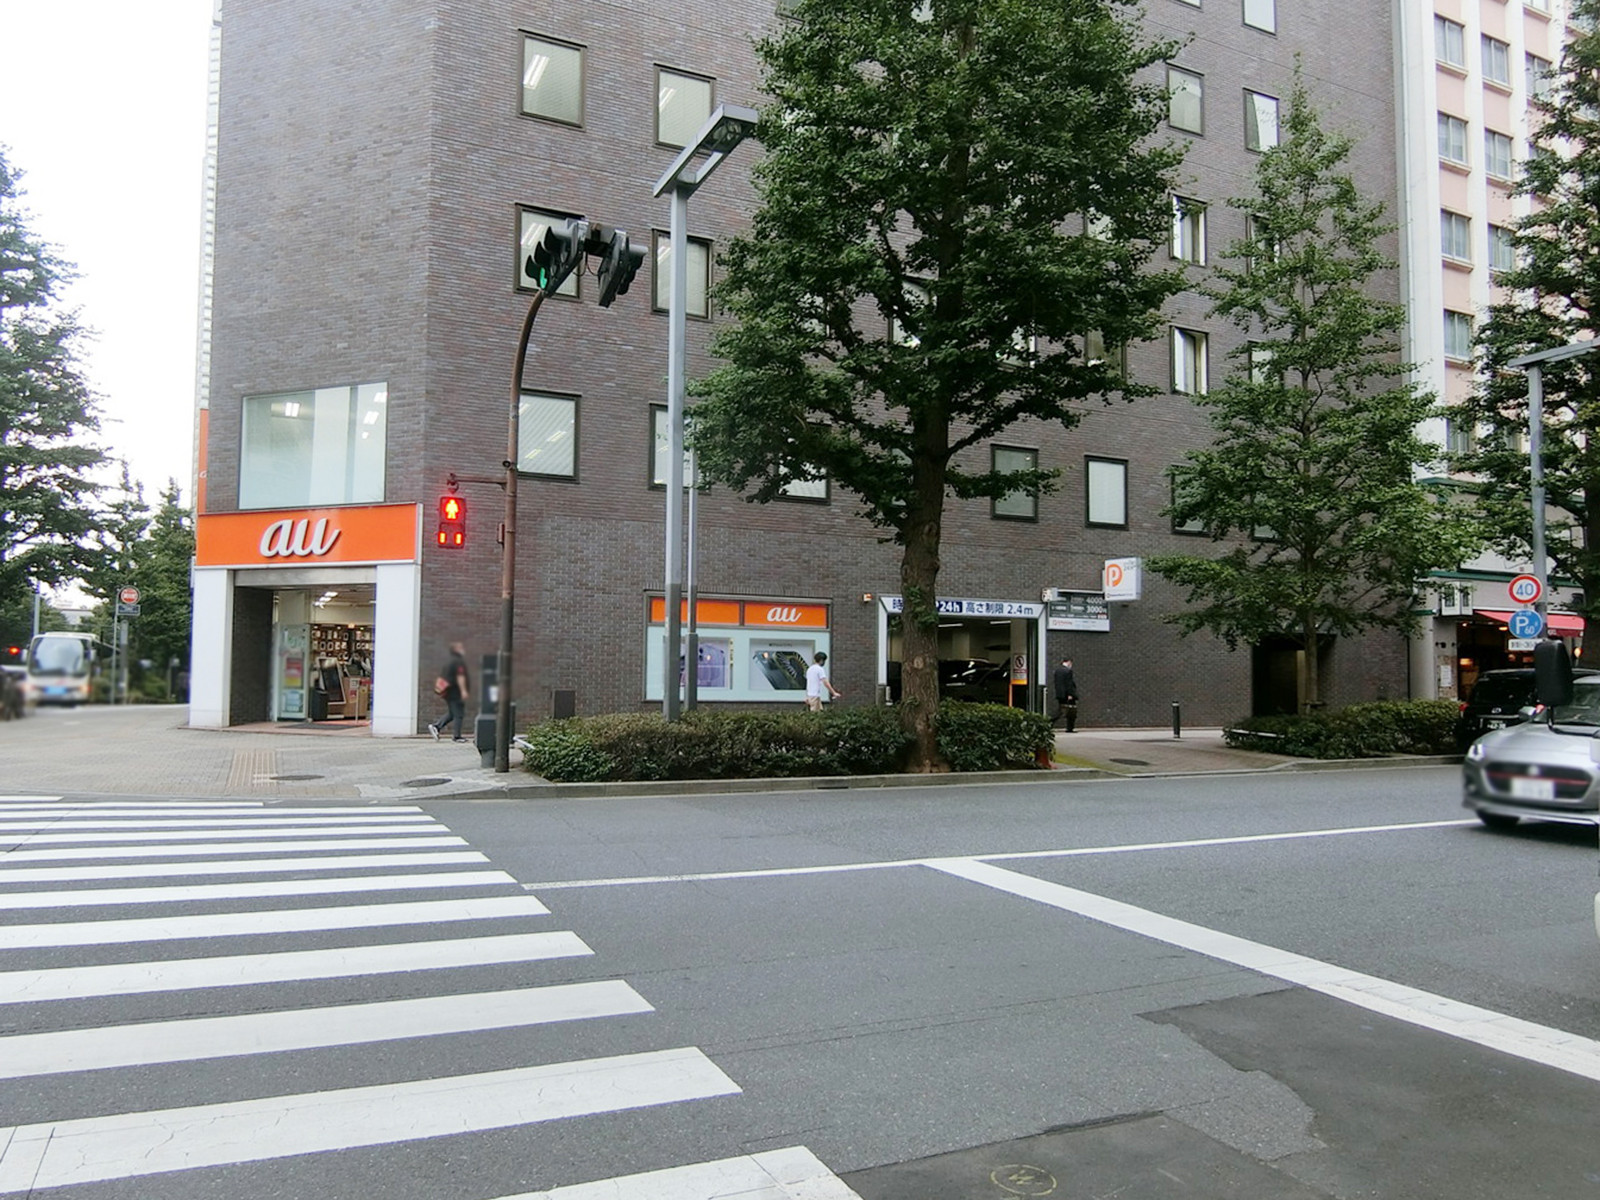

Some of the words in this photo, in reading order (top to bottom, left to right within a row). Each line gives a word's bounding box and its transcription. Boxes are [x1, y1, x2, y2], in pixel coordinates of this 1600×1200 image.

[259, 518, 341, 557] au
[1106, 564, 1123, 587] P
[1516, 583, 1534, 596] 40
[766, 607, 802, 622] au
[966, 602, 1004, 614] 高さ制限
[1007, 604, 1033, 615] 2.4m
[1515, 616, 1529, 635] P
[1524, 626, 1535, 635] 60
